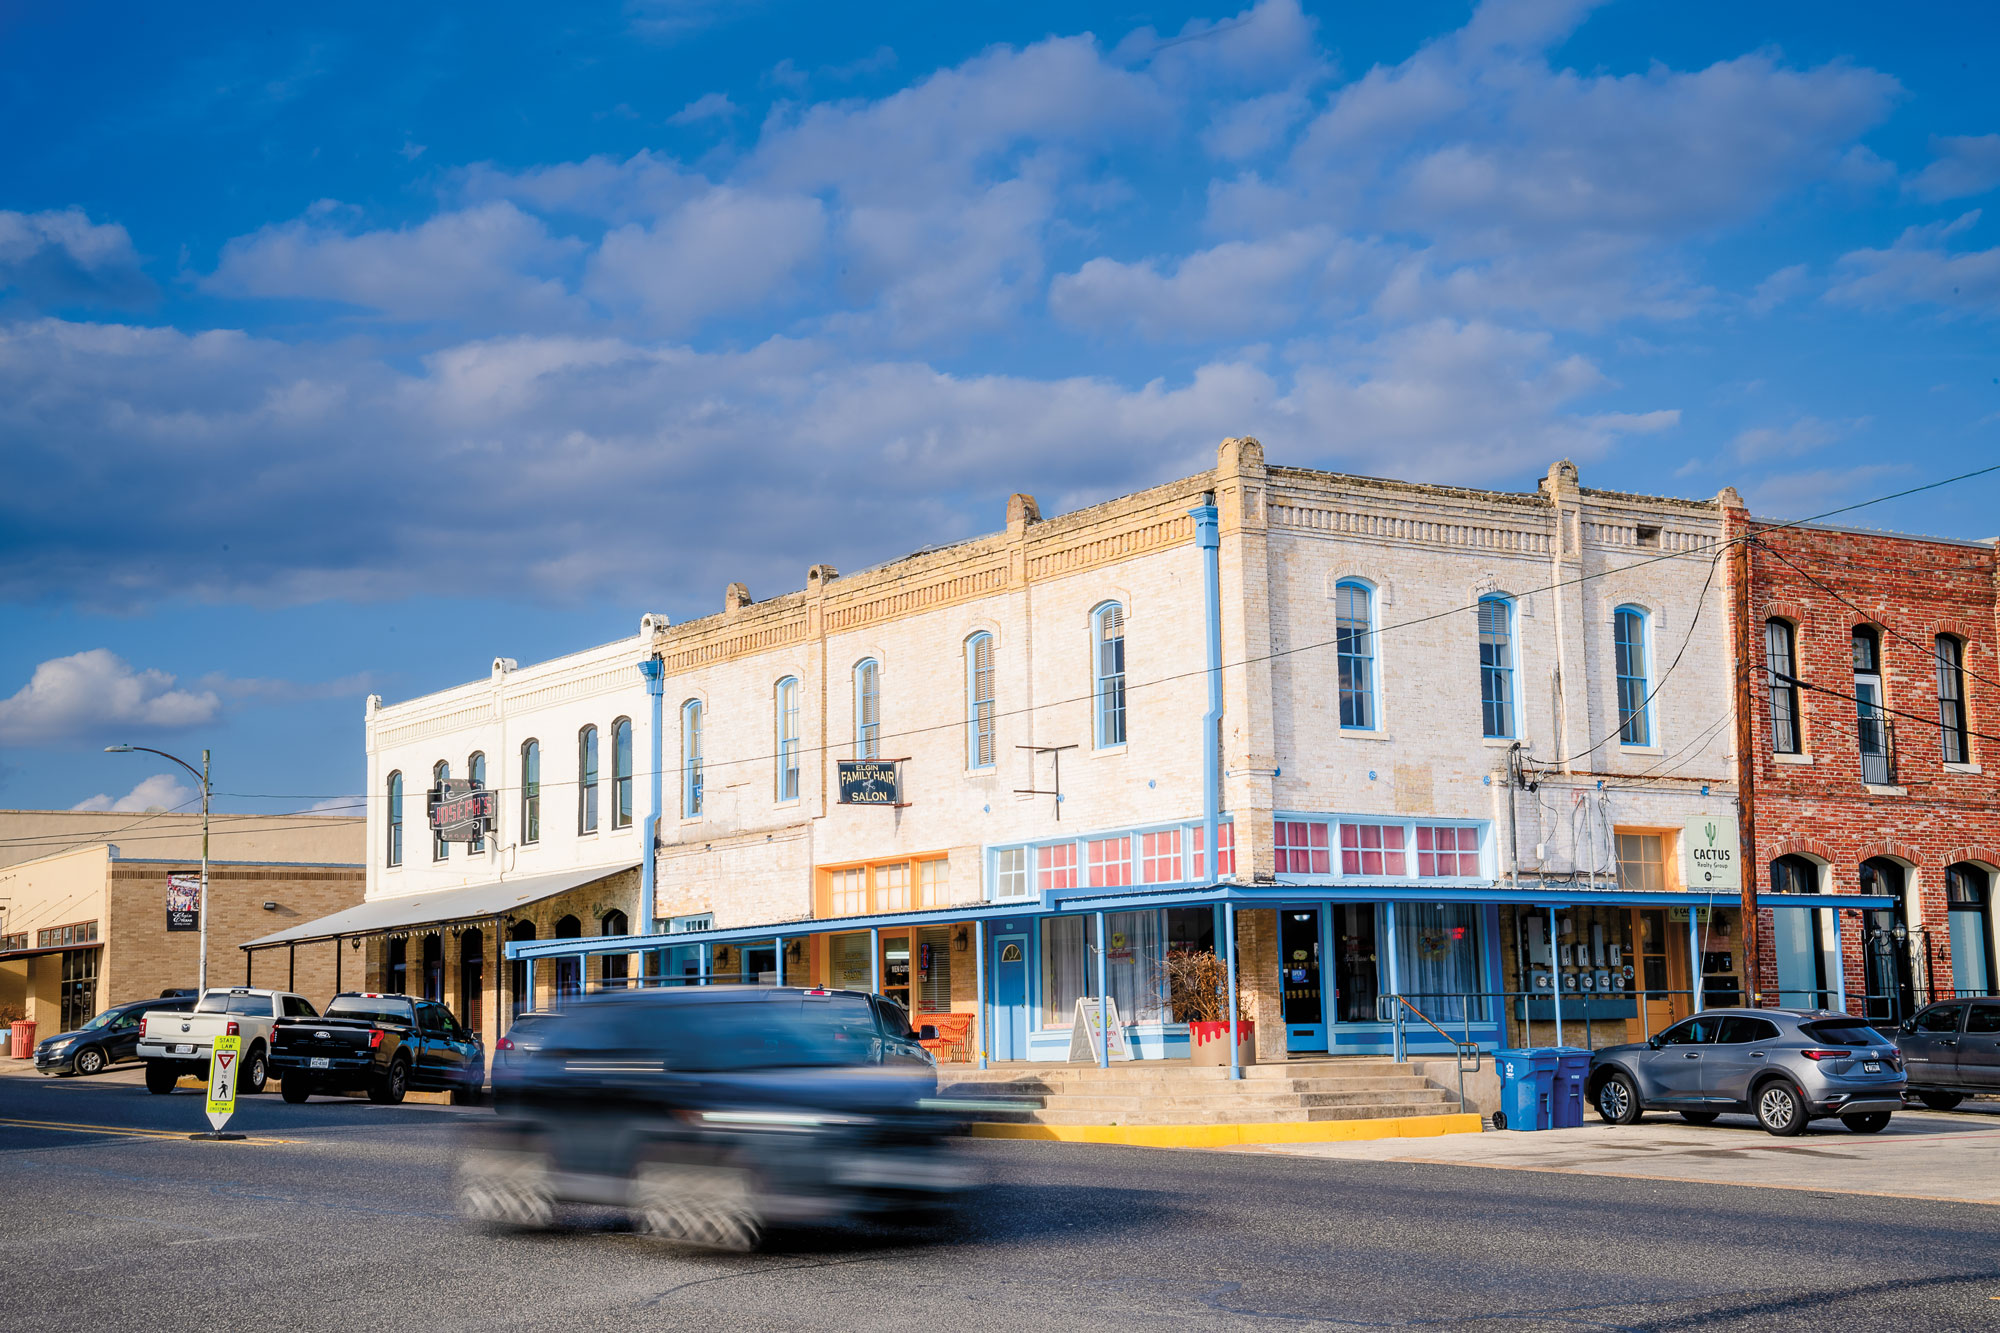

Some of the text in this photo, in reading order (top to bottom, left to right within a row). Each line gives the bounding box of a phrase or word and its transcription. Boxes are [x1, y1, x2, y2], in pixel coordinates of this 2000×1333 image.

[840, 771, 895, 787] FAMILY HAIR
[851, 791, 888, 802] SALON
[432, 796, 493, 825] JOSEPH'S
[1693, 848, 1731, 861] CACTUS
[1697, 861, 1713, 869] Realty
[1937, 944, 1945, 962] 4
